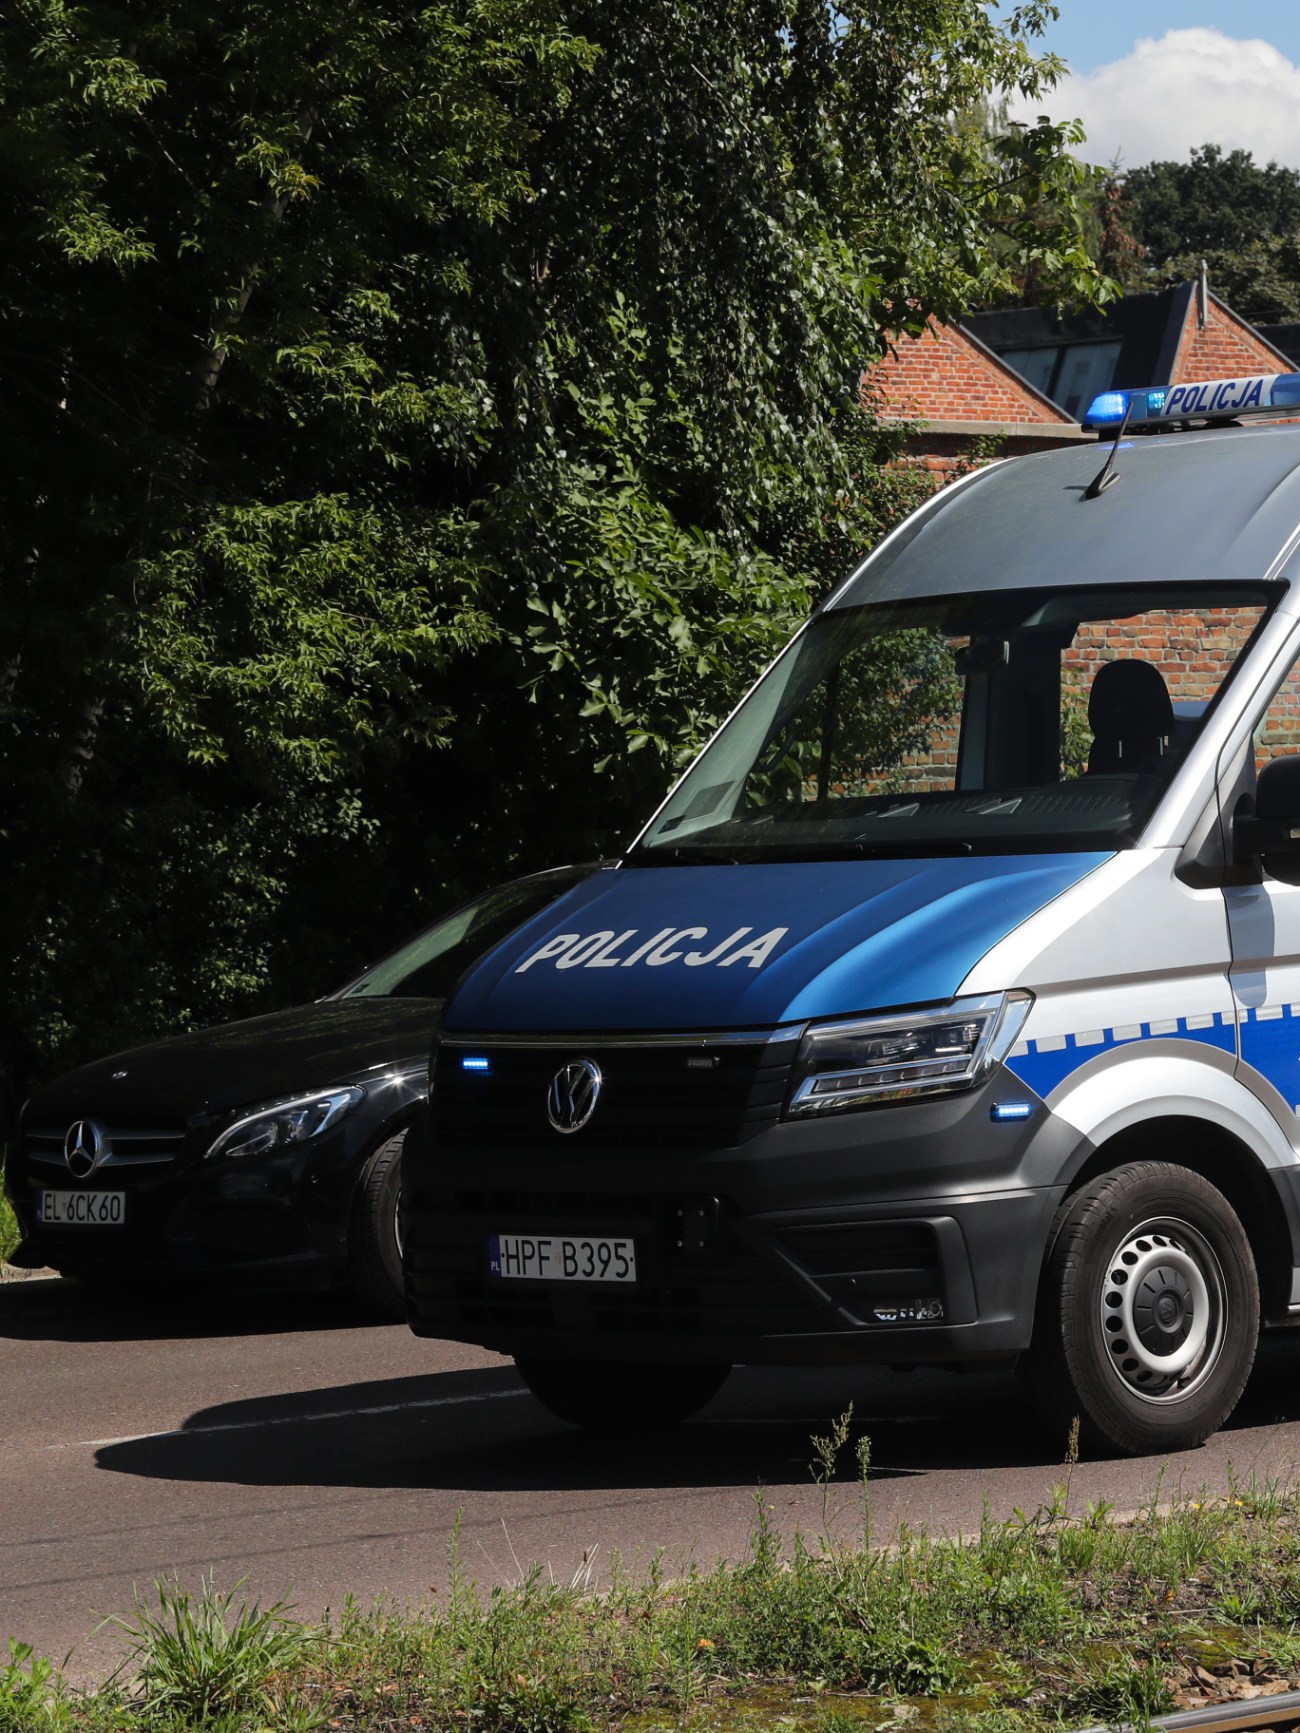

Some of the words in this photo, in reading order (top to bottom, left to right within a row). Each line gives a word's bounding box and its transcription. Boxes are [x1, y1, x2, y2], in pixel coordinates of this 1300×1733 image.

[1165, 379, 1263, 415] POLICJA
[515, 926, 789, 973] POLICJA
[44, 1193, 61, 1221] EL
[67, 1194, 121, 1222] 6CK60
[489, 1261, 500, 1271] PL
[504, 1239, 552, 1276] HPF
[562, 1241, 630, 1279] B395
